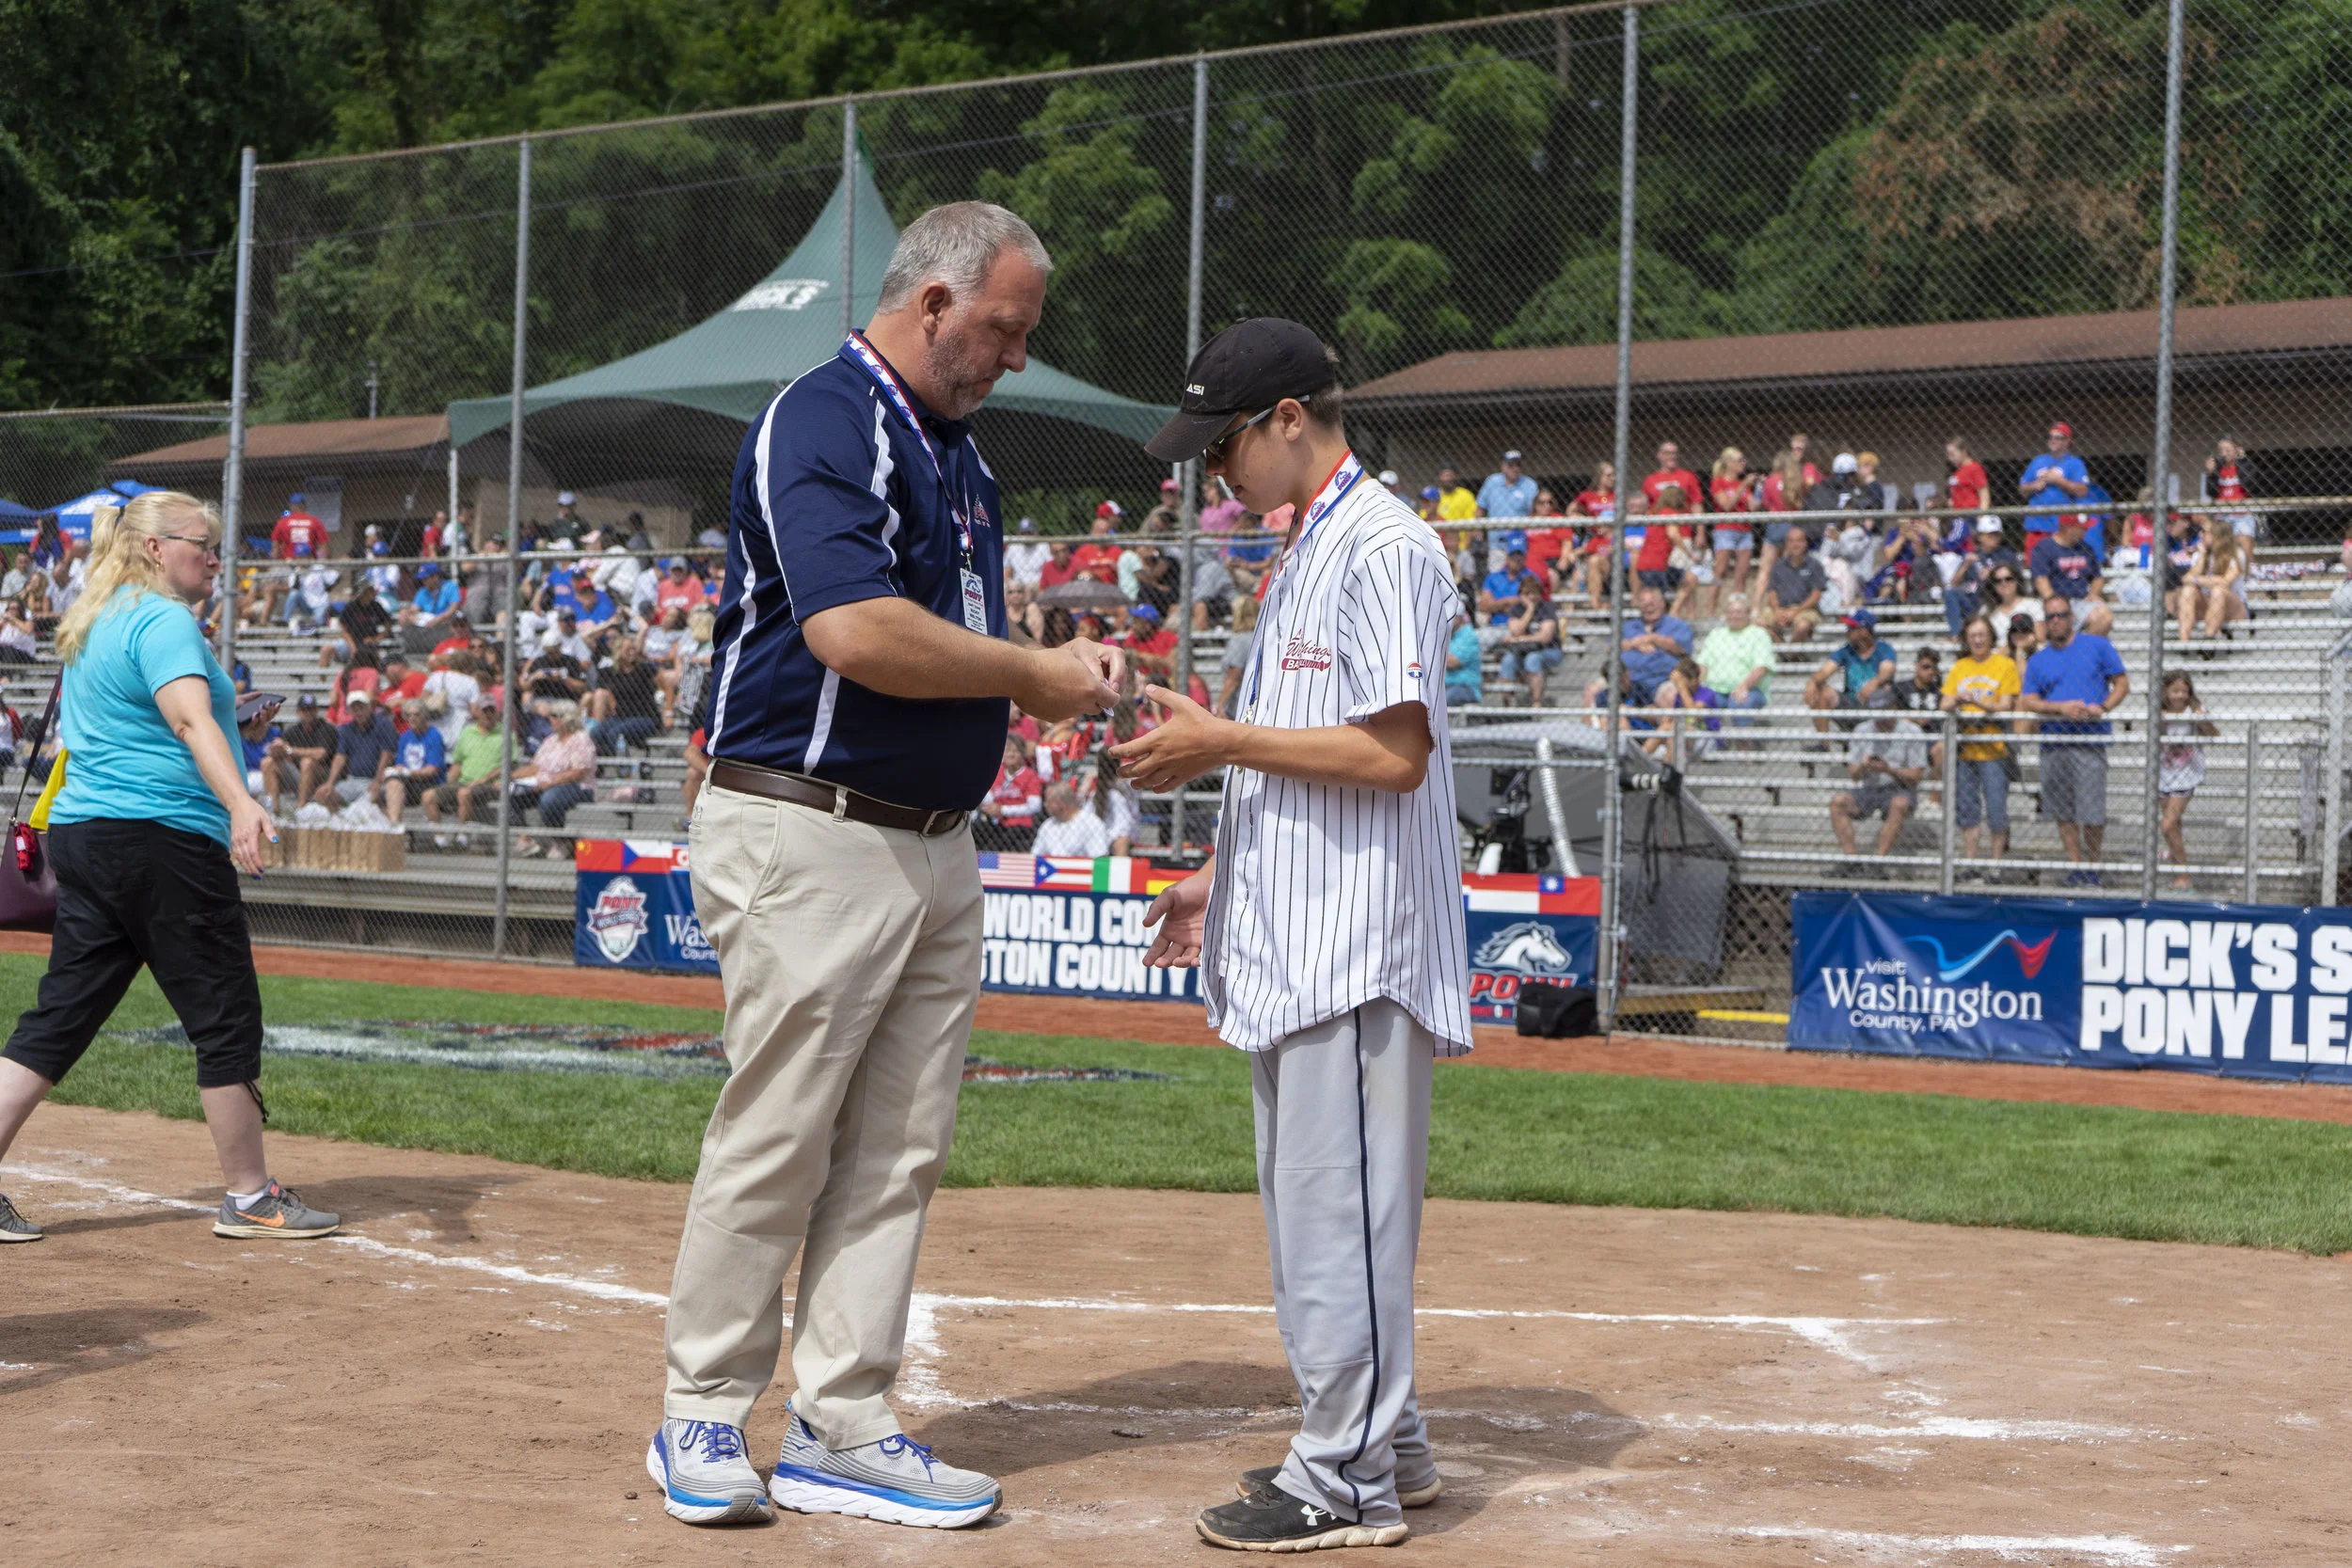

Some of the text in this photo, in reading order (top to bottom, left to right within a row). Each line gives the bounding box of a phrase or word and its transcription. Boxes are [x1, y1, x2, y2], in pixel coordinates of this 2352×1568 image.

[1186, 383, 1205, 396] ASI
[964, 588, 982, 601] PONY
[601, 895, 642, 910] PONY
[983, 893, 1095, 943] WORLD
[2082, 917, 2298, 991] DICK'S
[1864, 957, 1908, 976] visit
[1820, 966, 2043, 1028] Washington
[1930, 1015, 1959, 1033] PA
[2080, 985, 2352, 1066] PONY LE
